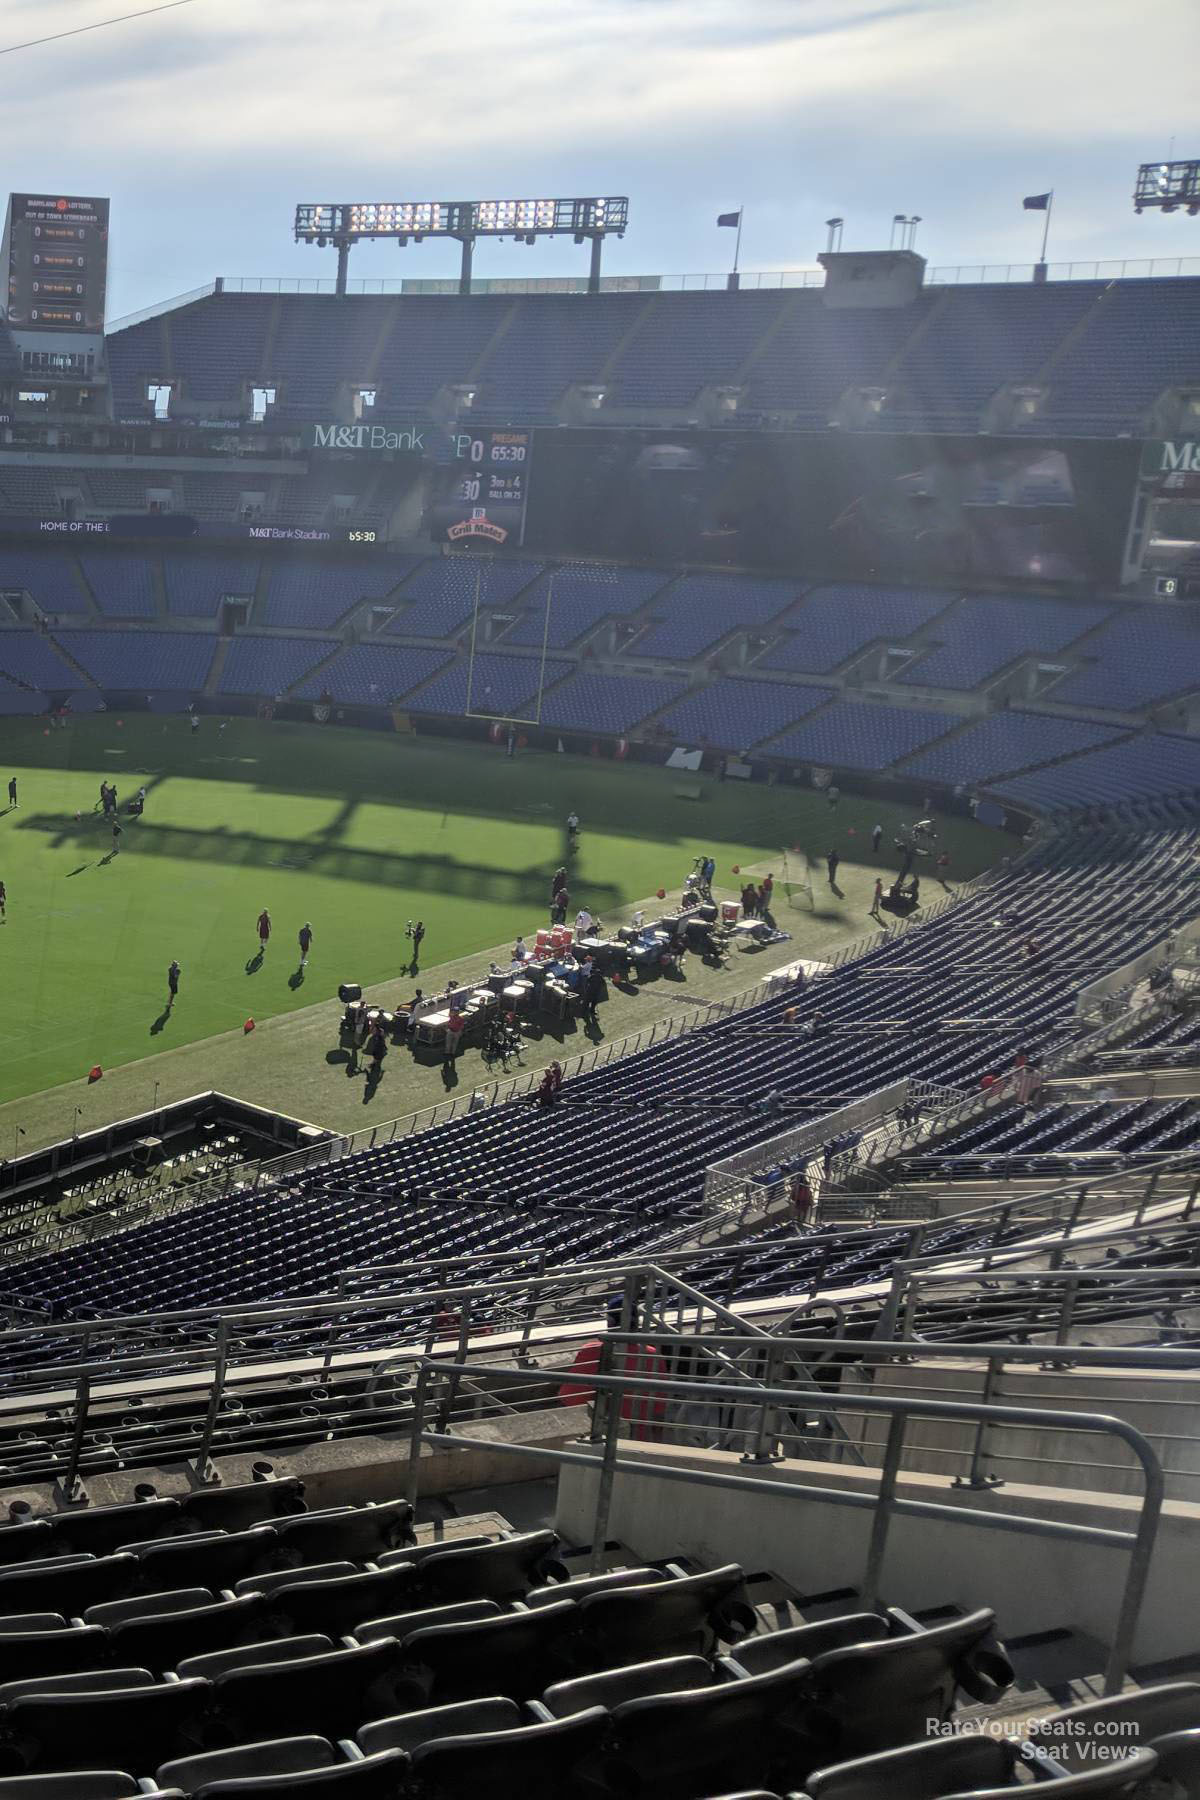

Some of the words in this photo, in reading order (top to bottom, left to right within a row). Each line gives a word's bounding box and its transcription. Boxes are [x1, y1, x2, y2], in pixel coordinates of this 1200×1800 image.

[313, 424, 370, 448] M&T
[371, 426, 425, 450] Bank
[471, 440, 484, 462] 0
[491, 446, 526, 461] 65:30
[40, 521, 67, 531] HOME
[69, 522, 83, 532] OF
[85, 522, 103, 532] THE
[249, 527, 272, 538] M&T
[272, 528, 294, 539] Bank
[294, 528, 330, 540] Stadium
[452, 524, 472, 537] Grill
